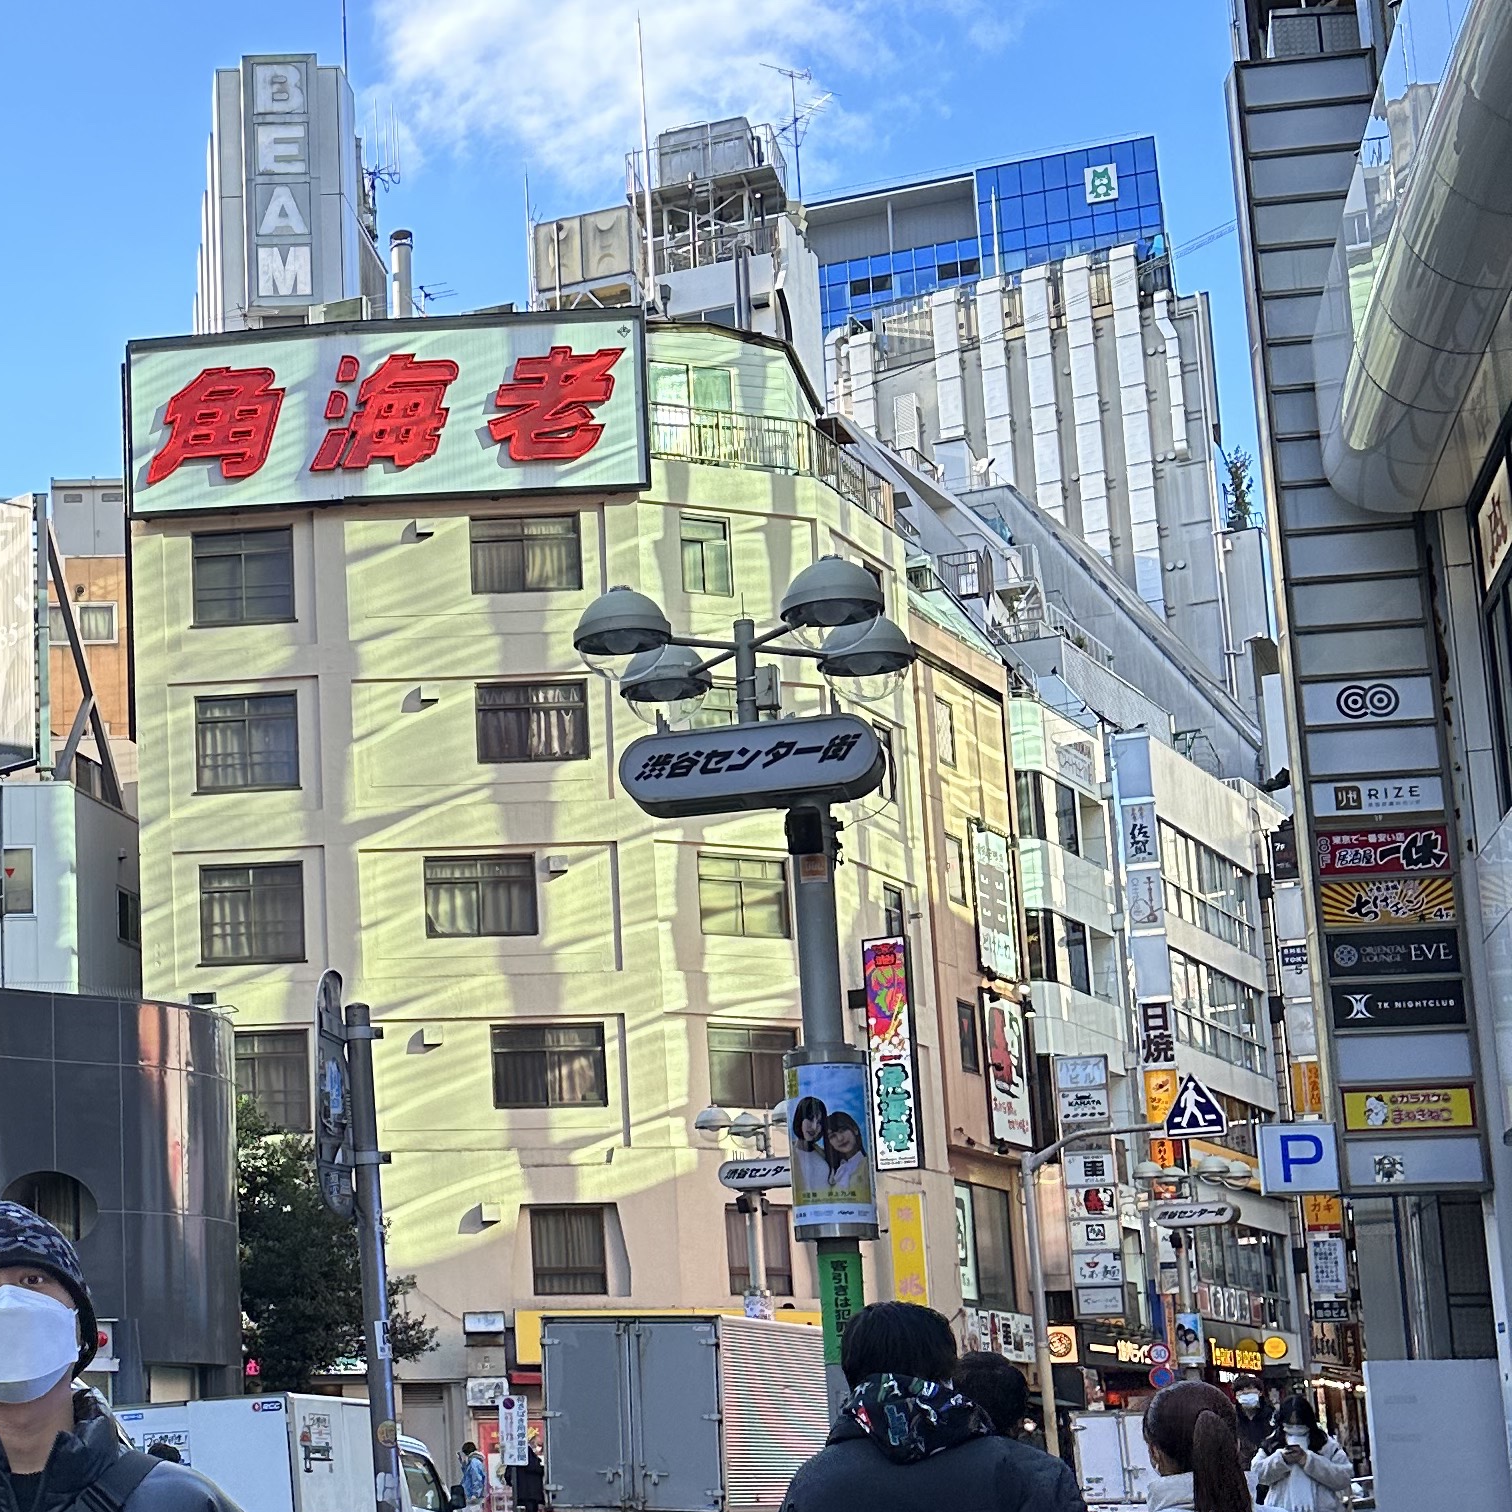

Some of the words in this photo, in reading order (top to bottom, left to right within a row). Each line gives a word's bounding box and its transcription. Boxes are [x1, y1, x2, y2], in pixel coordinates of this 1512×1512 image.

[256, 63, 313, 297] BEAM
[147, 345, 626, 486] 角海老
[634, 733, 863, 782] 渋谷センター街
[1367, 785, 1421, 801] RIZE
[1332, 832, 1406, 845] 東京で一番安い店
[1336, 847, 1375, 869] 居酒屋
[1377, 830, 1448, 870] 一休
[1433, 907, 1452, 920] 4F
[1361, 954, 1402, 963] LOUNGE
[1410, 942, 1453, 961] EVE
[1377, 1001, 1390, 1010] TK
[1394, 999, 1455, 1009] NIGHTCLUB
[1141, 1002, 1175, 1063] 日焼
[1396, 1092, 1443, 1104] カラオケ
[1392, 1107, 1453, 1125] まねきねこ
[1280, 1134, 1324, 1183] P
[724, 1165, 792, 1181] 渋谷センター
[1156, 1206, 1229, 1222] 渋谷センター街
[1153, 1349, 1167, 1359] 30
